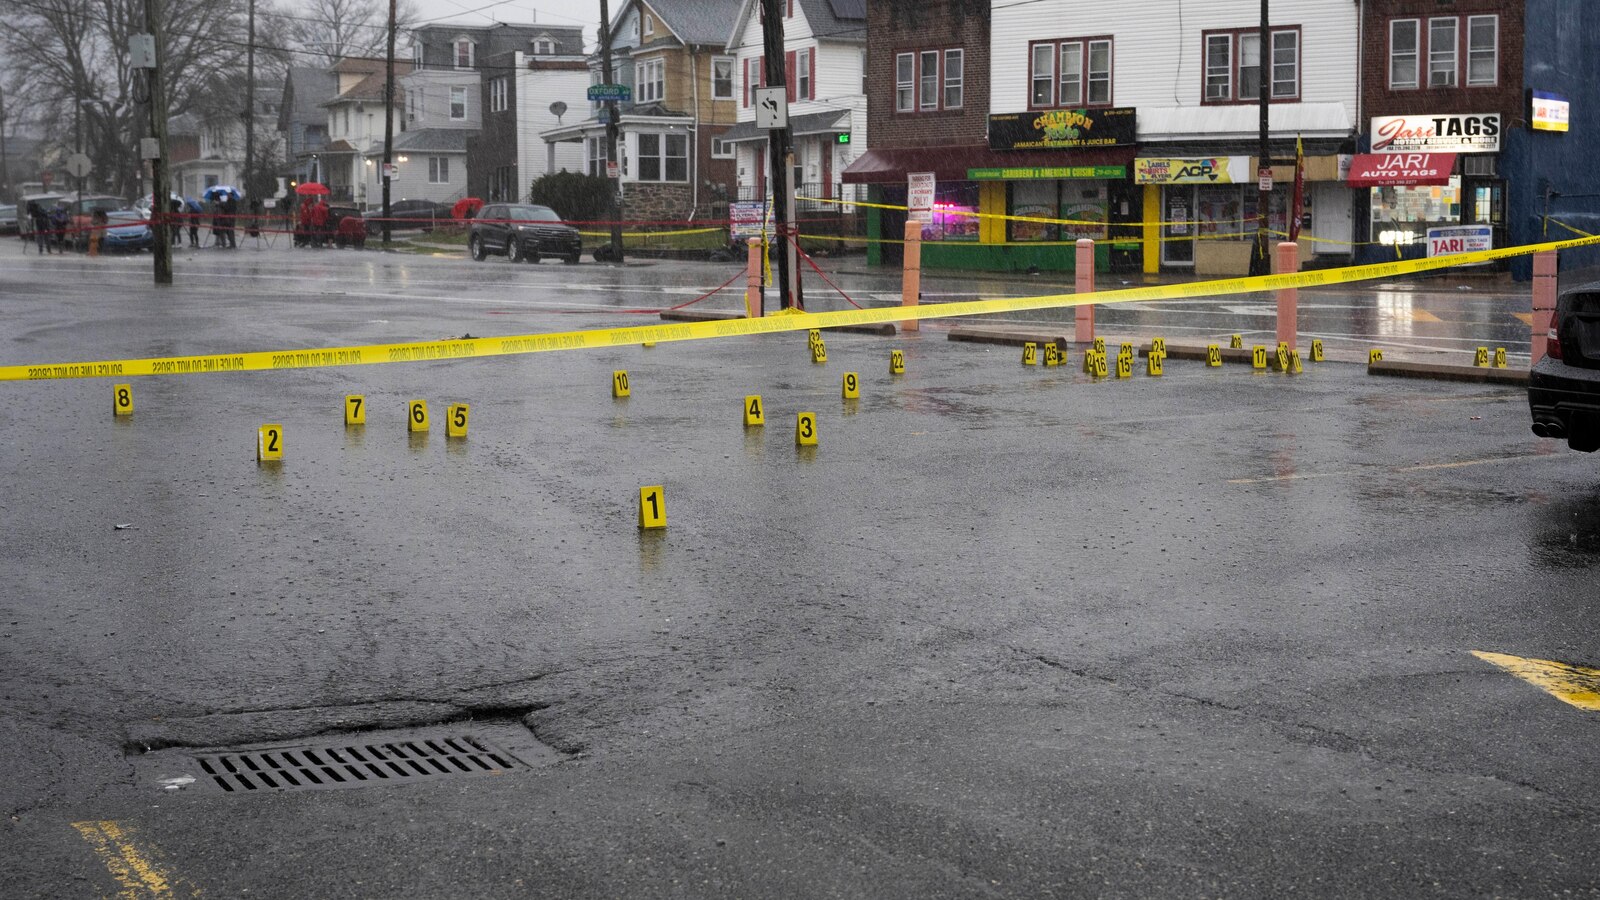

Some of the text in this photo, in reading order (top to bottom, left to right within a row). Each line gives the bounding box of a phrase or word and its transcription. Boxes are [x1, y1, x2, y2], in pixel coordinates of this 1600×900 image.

[1033, 110, 1094, 130] CHAMPION
[1372, 116, 1498, 150] Jari TAGS
[1377, 154, 1430, 170] JARI
[1002, 169, 1033, 178] CARIBBEAN
[1040, 168, 1070, 177] AMERICAN
[1072, 167, 1095, 176] CUISINE
[1172, 166, 1212, 181] ACP
[1432, 238, 1464, 256] JARI
[815, 343, 825, 357] 33
[1026, 346, 1035, 360] 27
[1047, 346, 1056, 360] 25
[1096, 340, 1105, 354] 26
[1154, 340, 1164, 354] 24
[894, 354, 903, 368] 22
[1151, 355, 1161, 370] 14
[1210, 348, 1220, 362] 20
[1256, 349, 1265, 364] 17
[1280, 350, 1288, 364] 13
[1096, 357, 1106, 372] 16
[1120, 357, 1130, 372] 15
[617, 373, 629, 390] 10
[847, 374, 856, 391] 9
[118, 388, 130, 407] 8
[350, 399, 362, 418] 7
[413, 404, 424, 423] 6
[750, 399, 760, 418] 4
[454, 407, 466, 427] 5
[801, 417, 812, 438] 3
[268, 430, 278, 451] 2
[647, 492, 658, 519] 1
